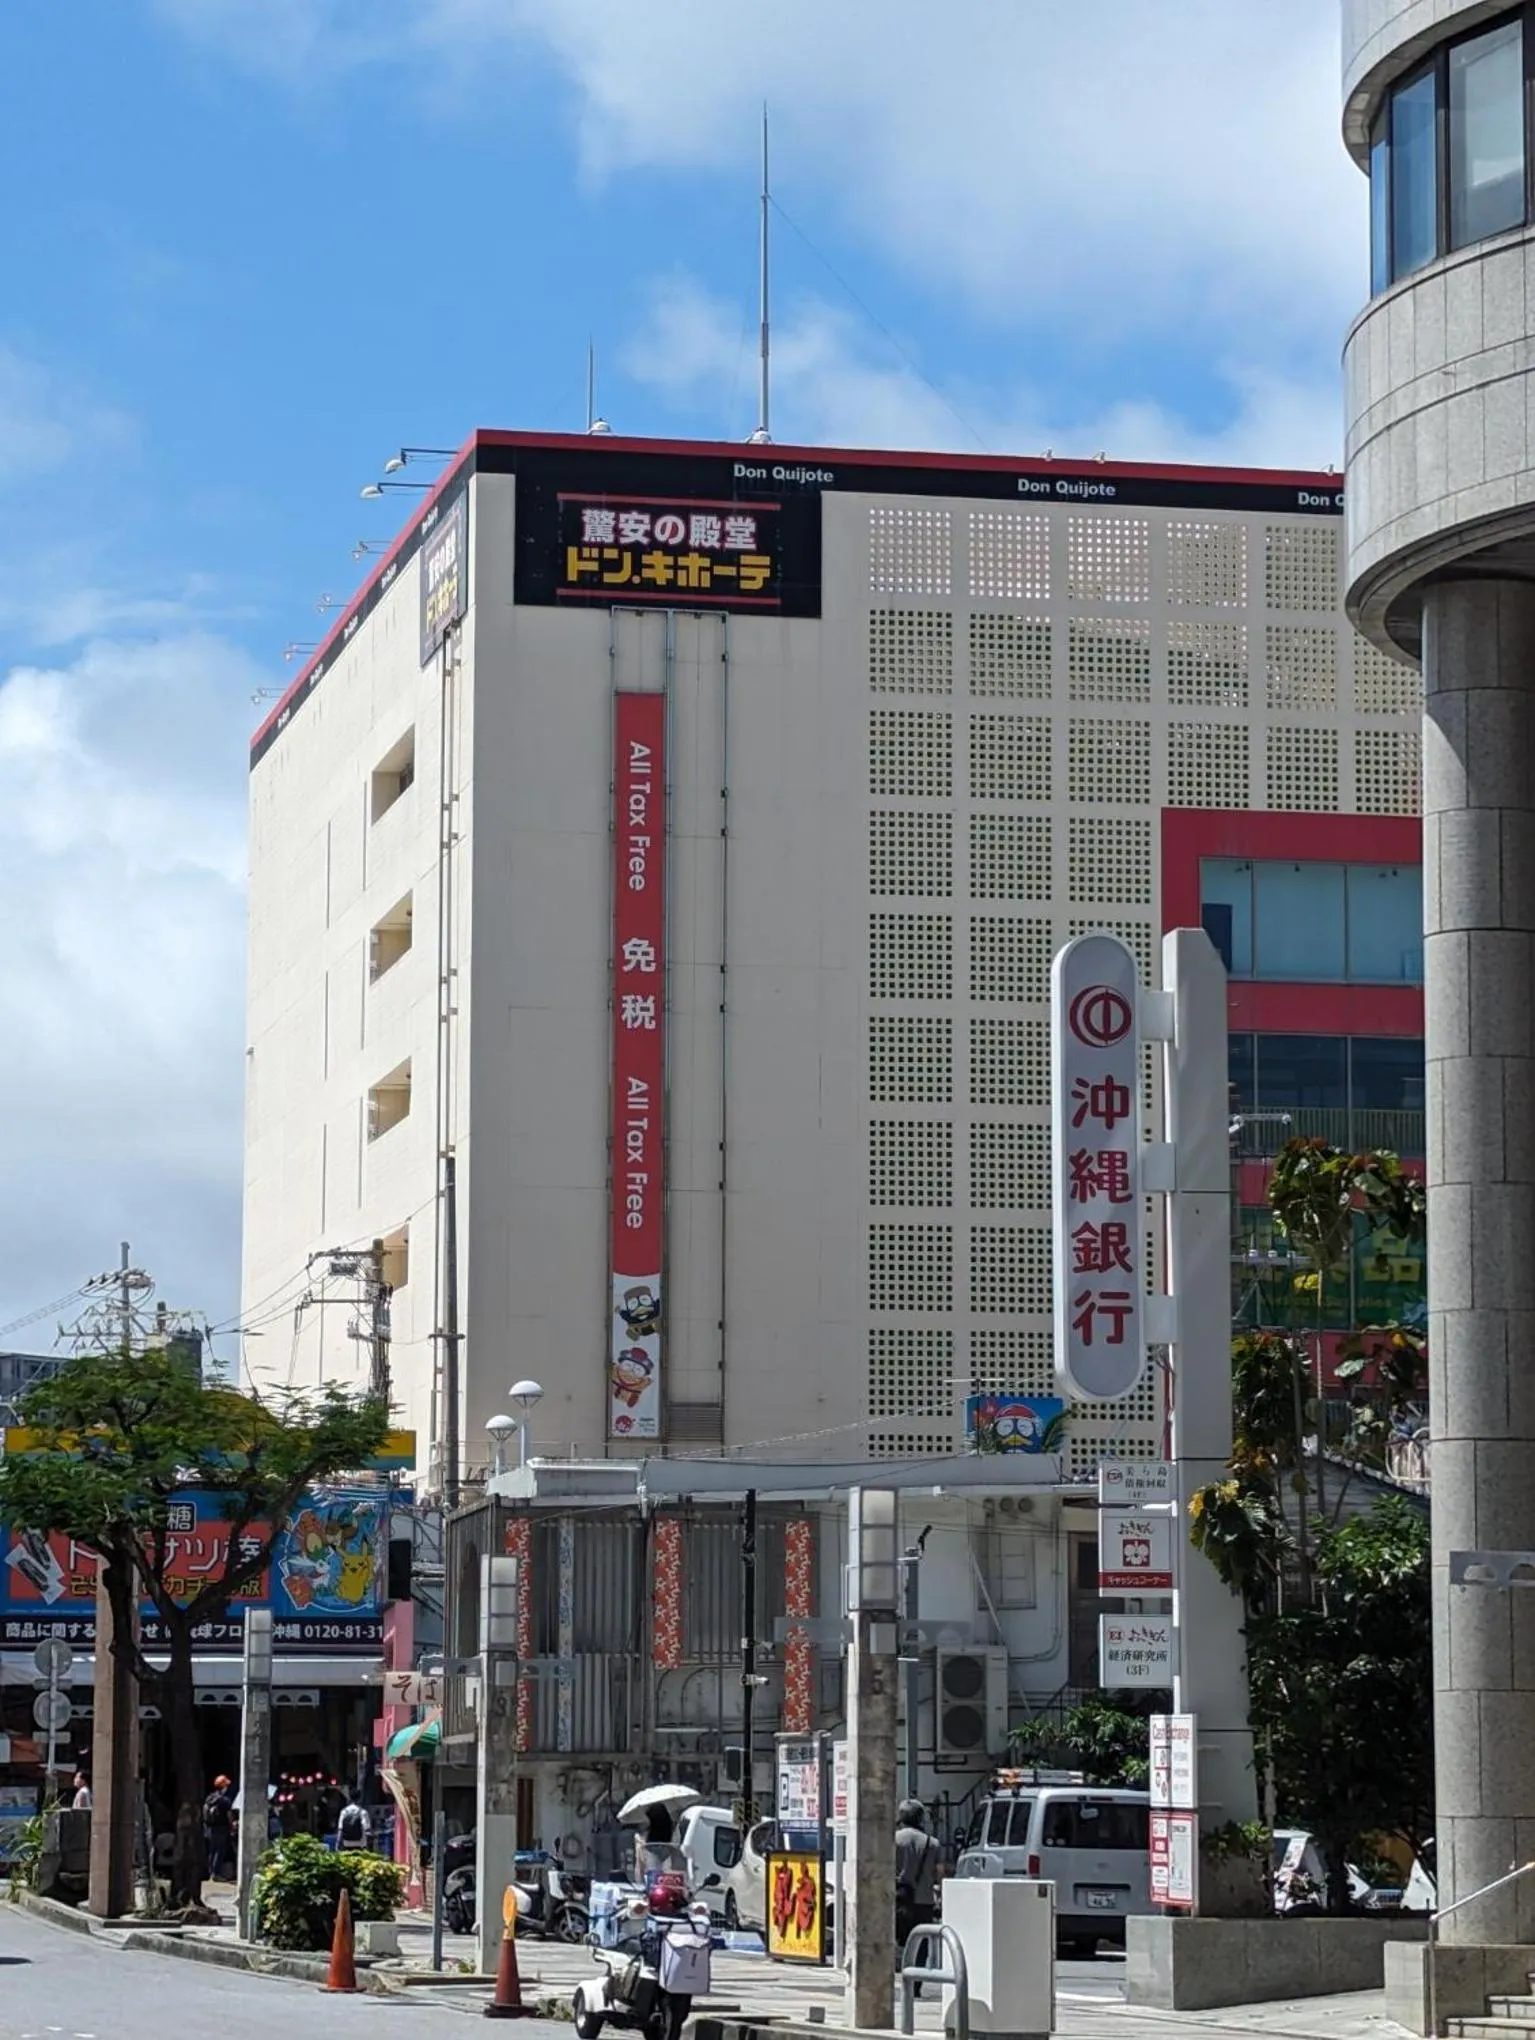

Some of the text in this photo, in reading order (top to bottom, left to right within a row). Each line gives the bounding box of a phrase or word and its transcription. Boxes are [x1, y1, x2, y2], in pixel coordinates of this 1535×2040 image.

[734, 464, 834, 484] Don Quijote
[1017, 478, 1116, 498] Don Quijote
[1298, 492, 1330, 506] Don
[582, 508, 757, 550] 驚安の殿堂
[629, 741, 651, 891] All Tax Free
[621, 938, 657, 1029] 免税
[626, 1076, 648, 1229] All Tax Free
[1068, 1074, 1134, 1347] 沖縄銀行
[1108, 1649, 1168, 1663] 経済研究所
